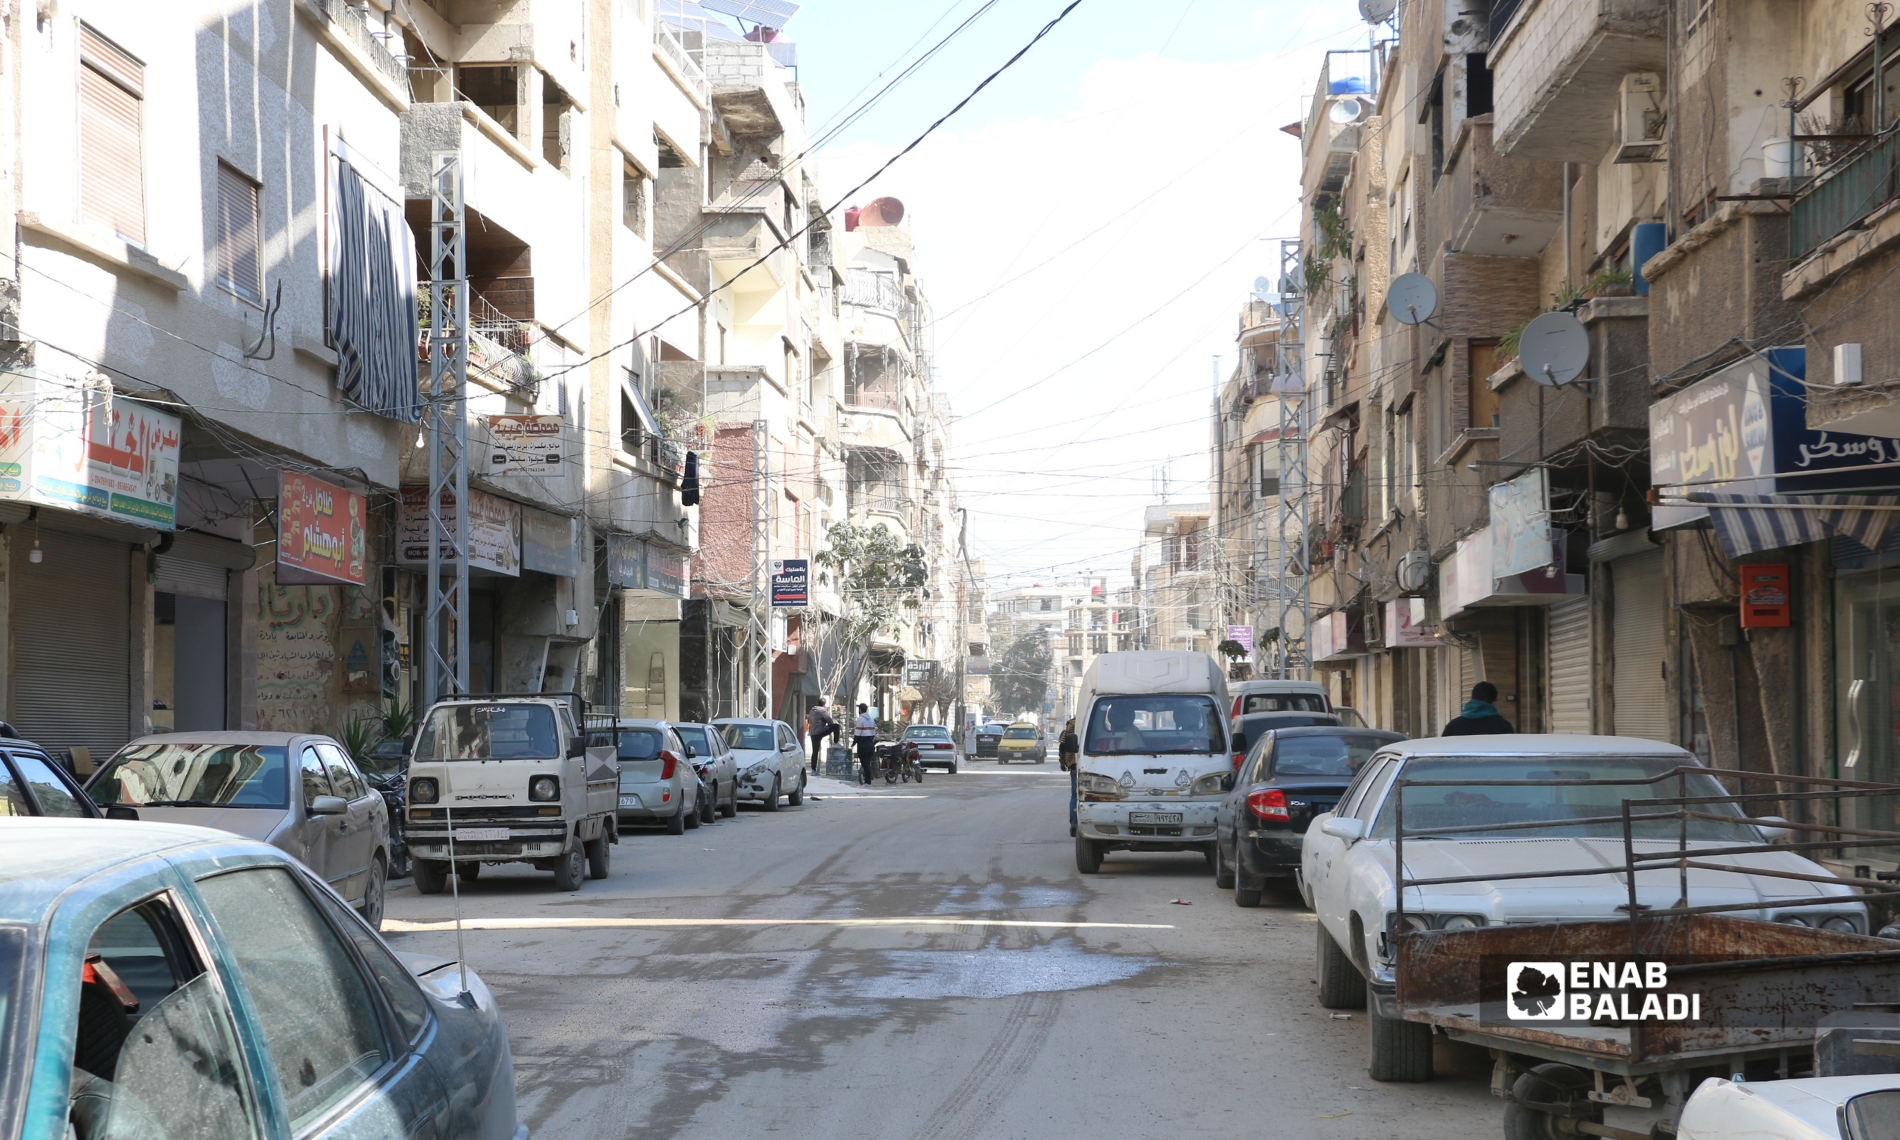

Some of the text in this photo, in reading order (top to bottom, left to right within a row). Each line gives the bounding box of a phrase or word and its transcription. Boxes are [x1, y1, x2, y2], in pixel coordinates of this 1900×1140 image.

[151, 418, 179, 452] معرض
[313, 487, 334, 516] فلافل
[775, 575, 805, 583] الماسة
[455, 793, 514, 801] HONDA
